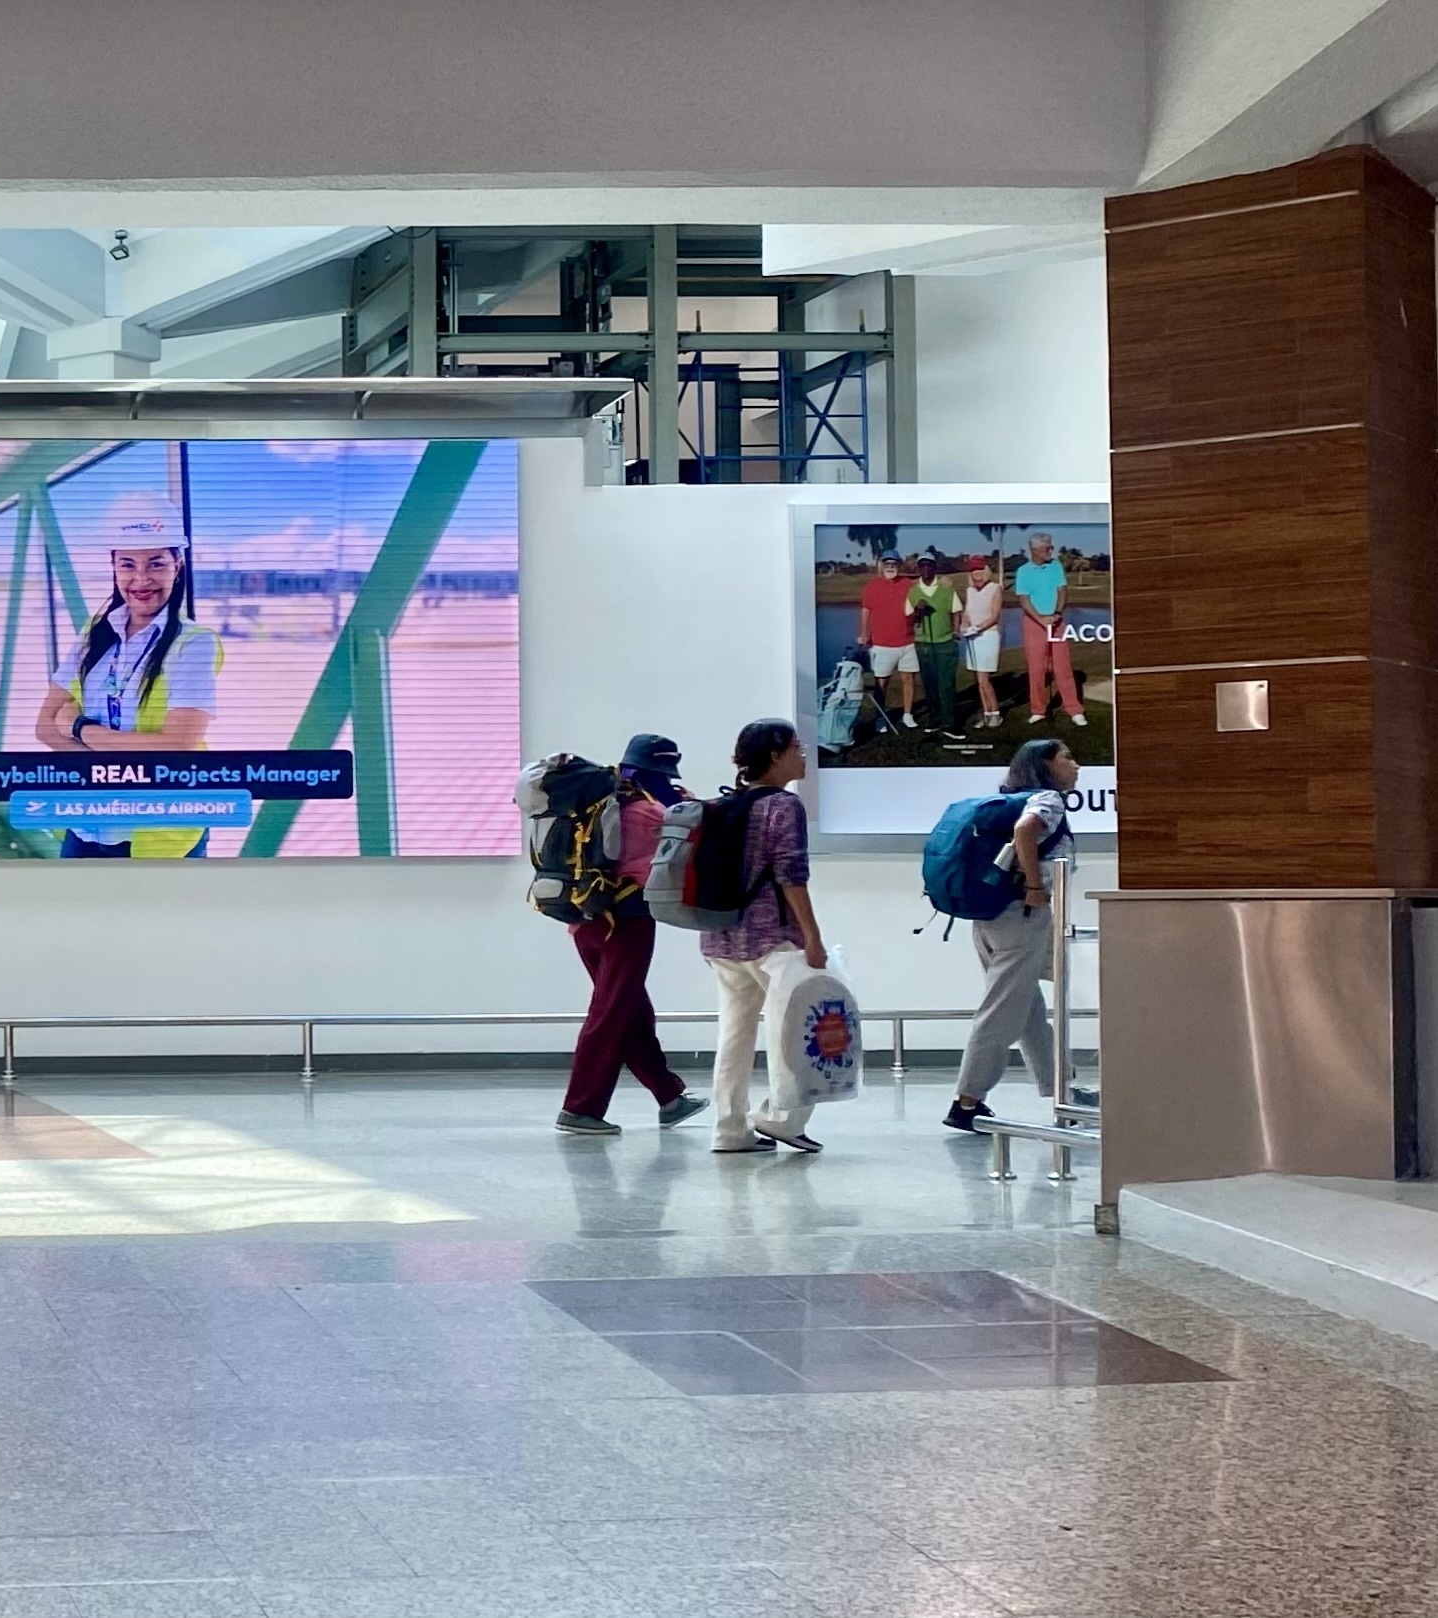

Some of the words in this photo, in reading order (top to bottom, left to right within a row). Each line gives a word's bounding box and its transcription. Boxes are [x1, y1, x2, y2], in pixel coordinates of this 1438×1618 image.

[91, 765, 151, 783] REAL
[155, 766, 241, 786] Projects
[246, 766, 340, 787] Manager
[55, 803, 84, 815] LAS
[87, 800, 165, 815] AMÉRICAS
[169, 803, 236, 815] AIRPORT
